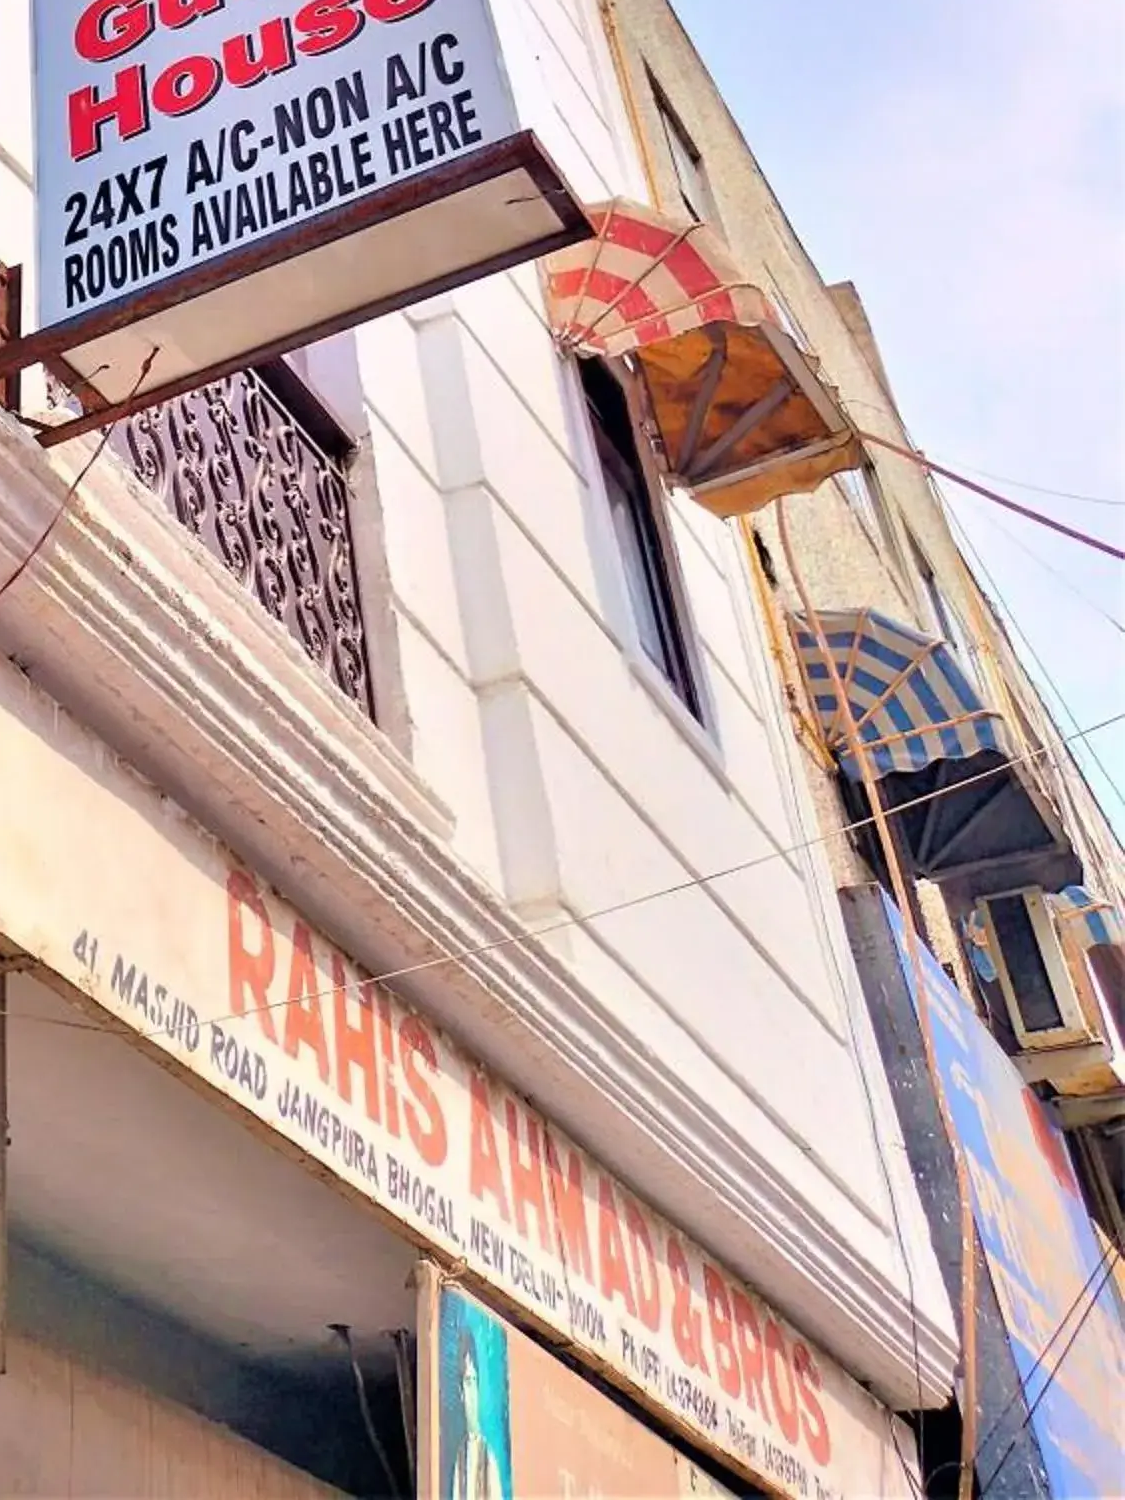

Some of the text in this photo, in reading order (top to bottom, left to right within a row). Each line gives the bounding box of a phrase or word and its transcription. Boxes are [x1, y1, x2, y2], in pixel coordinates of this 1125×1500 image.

[64, 157, 169, 246] 24X7
[386, 32, 465, 110] A/C
[65, 89, 482, 308] ROOMS AVAILABLE HERE
[110, 953, 200, 1054] MASJID
[209, 1019, 269, 1102] ROAD
[277, 1078, 380, 1187] JANGPURA
[470, 1216, 504, 1276] NEW
[226, 869, 449, 1168] RAHIS
